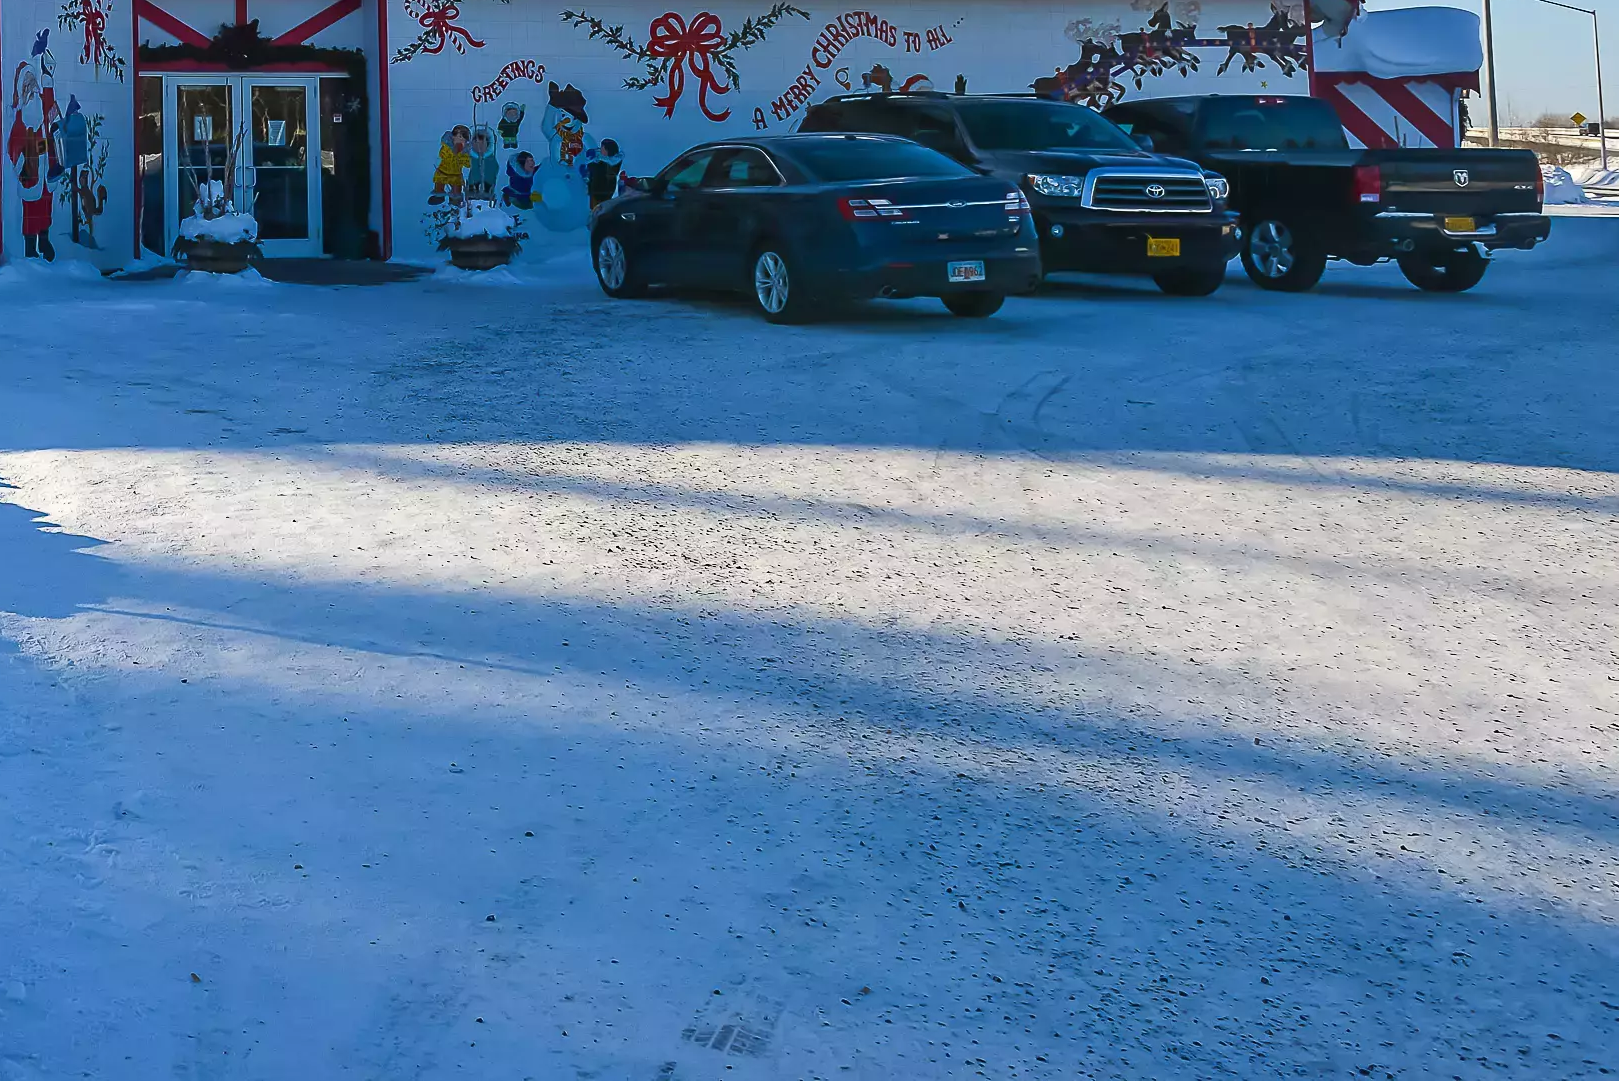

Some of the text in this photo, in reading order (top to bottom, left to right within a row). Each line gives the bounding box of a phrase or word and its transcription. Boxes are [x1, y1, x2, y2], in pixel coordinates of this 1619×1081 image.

[471, 59, 546, 103] GREETINGS
[752, 107, 768, 131] A
[771, 63, 821, 122] MERRY
[811, 11, 897, 69] CHRISTMAS
[903, 31, 921, 53] TO
